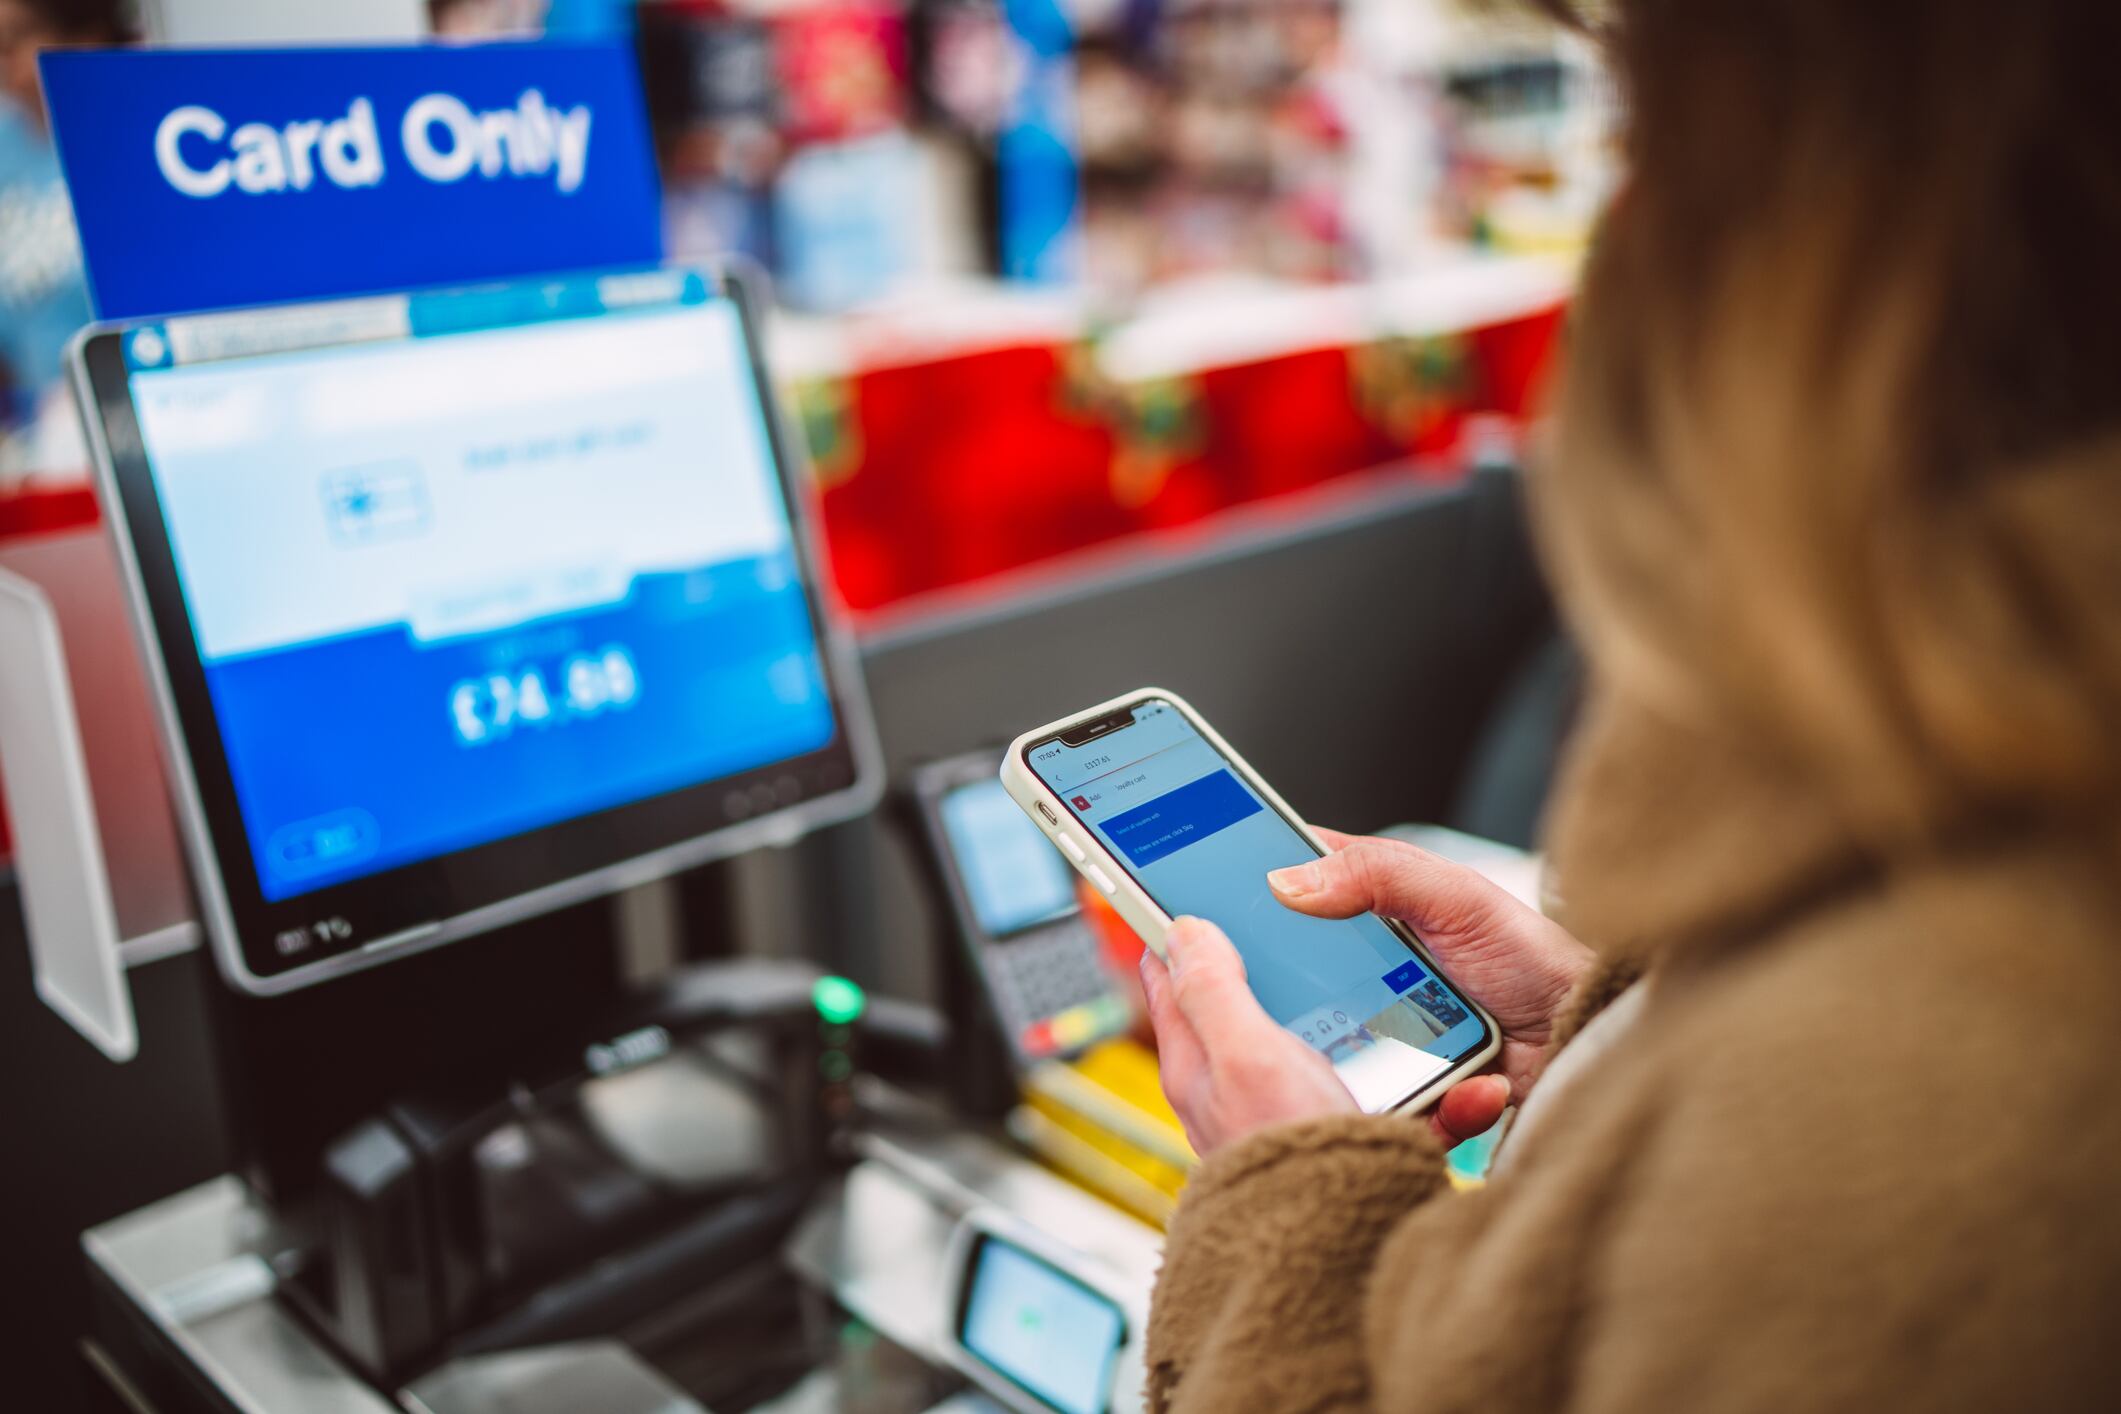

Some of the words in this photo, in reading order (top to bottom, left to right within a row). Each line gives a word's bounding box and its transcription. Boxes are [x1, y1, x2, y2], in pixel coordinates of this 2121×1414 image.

[156, 96, 384, 198] Card
[402, 88, 591, 194] Only
[1037, 750, 1056, 761] 17:03
